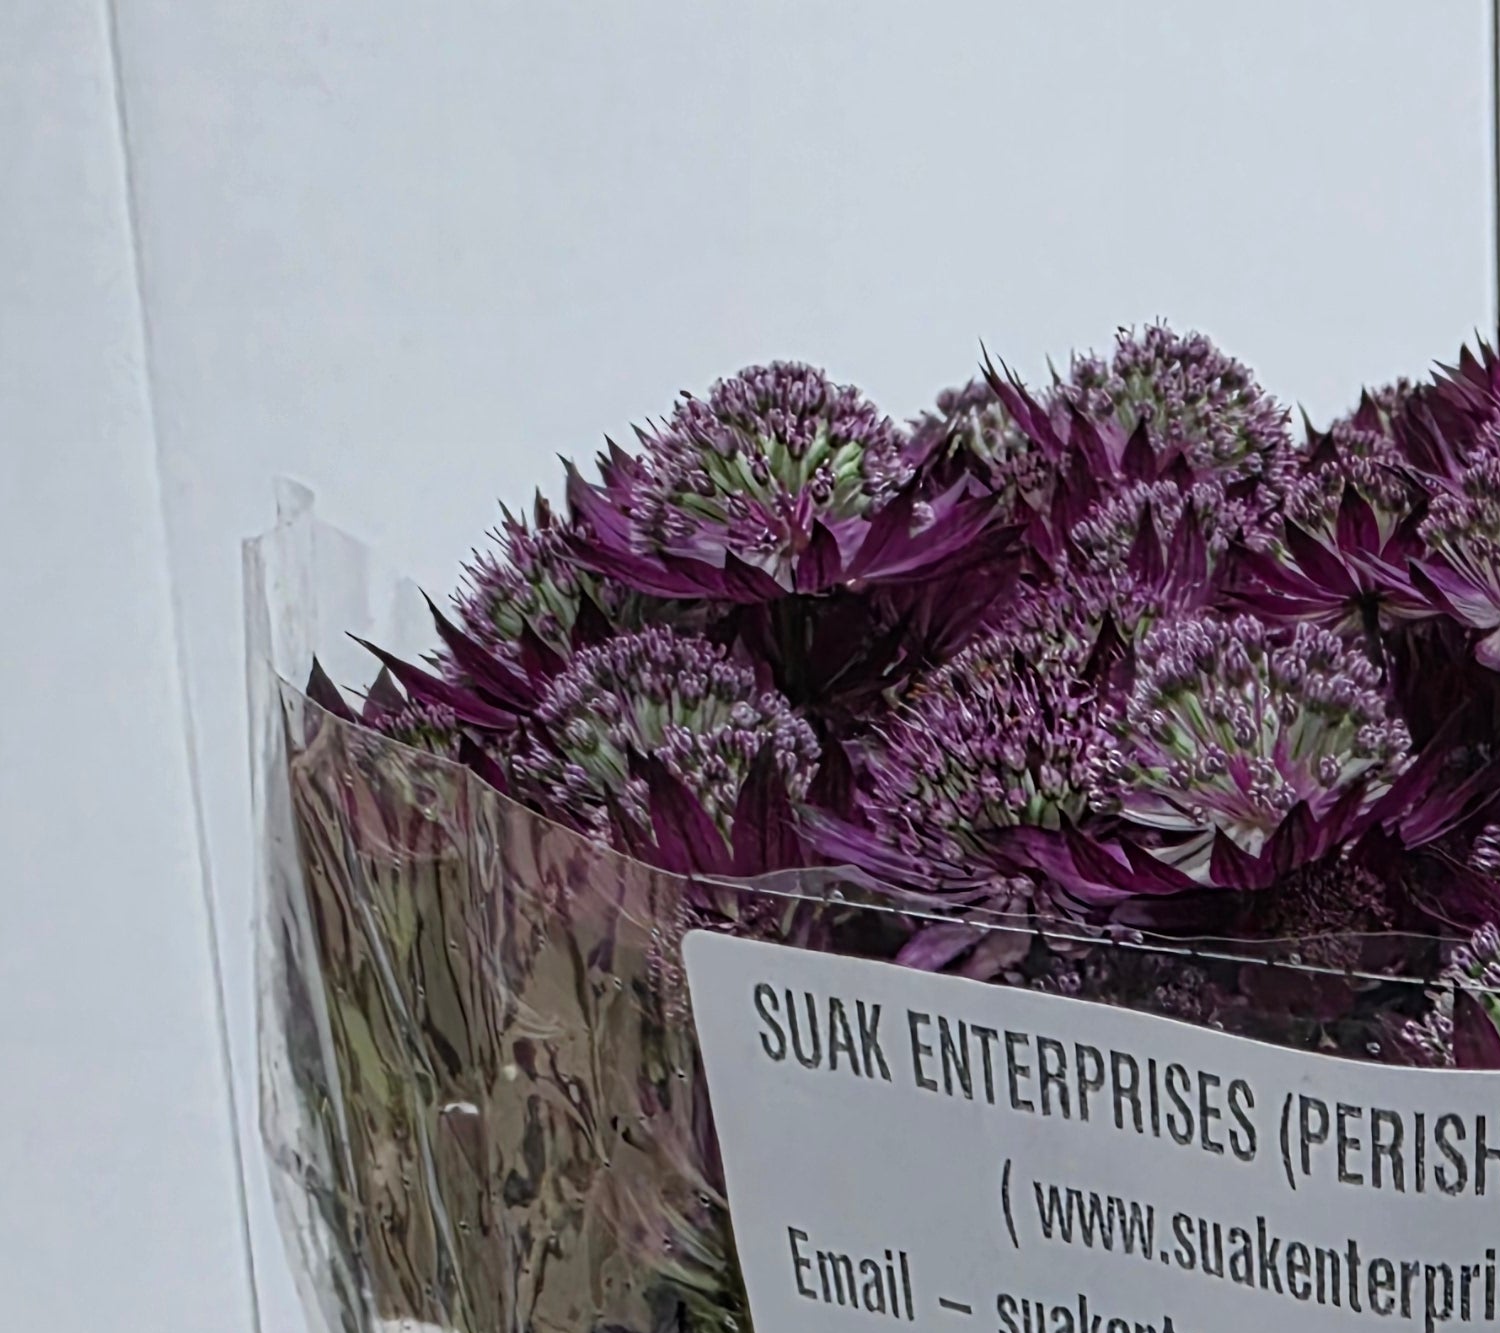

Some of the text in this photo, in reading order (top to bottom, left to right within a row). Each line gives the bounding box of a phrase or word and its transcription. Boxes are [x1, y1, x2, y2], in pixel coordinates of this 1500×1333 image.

[754, 983, 892, 1082] SUAK
[907, 1009, 1256, 1161] ENTERPRISES
[788, 1226, 914, 1321] Email
